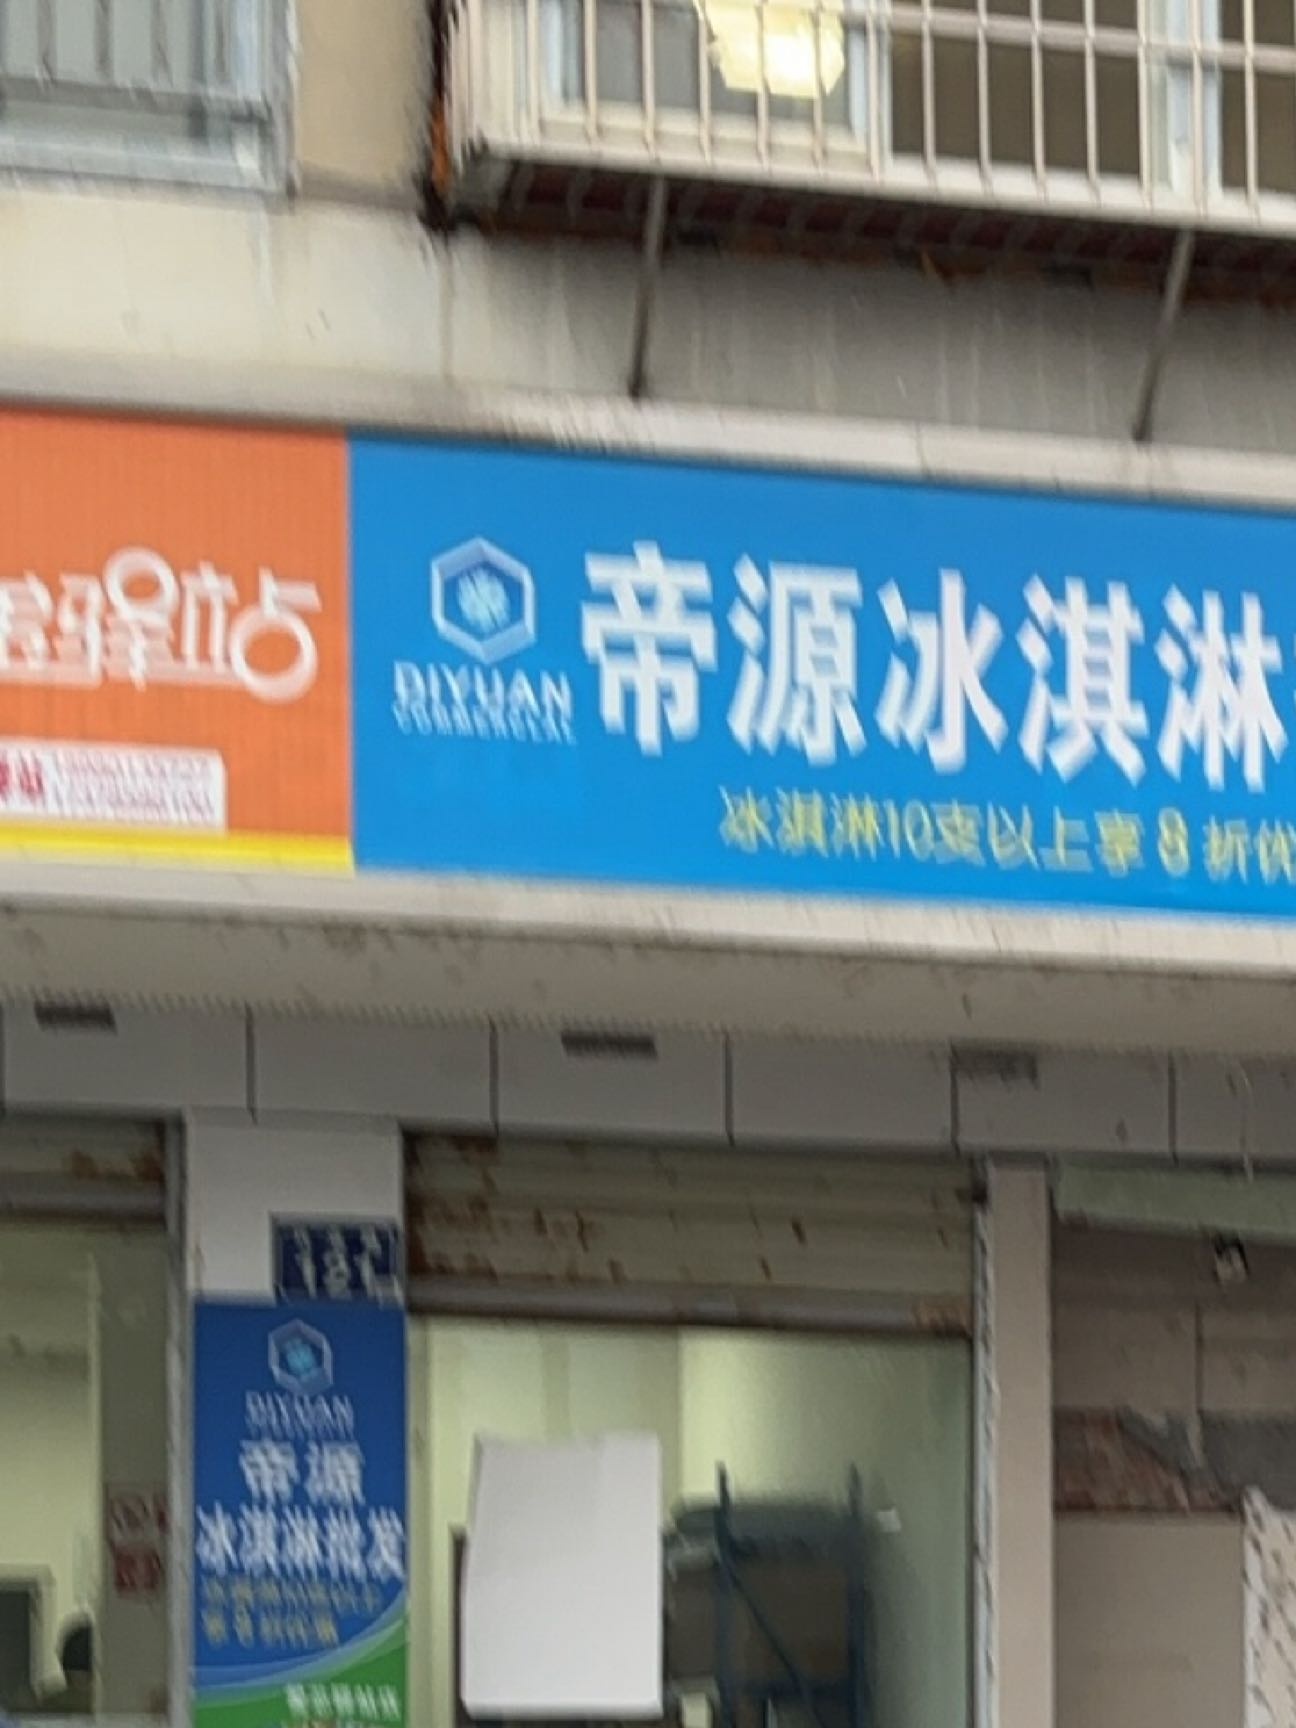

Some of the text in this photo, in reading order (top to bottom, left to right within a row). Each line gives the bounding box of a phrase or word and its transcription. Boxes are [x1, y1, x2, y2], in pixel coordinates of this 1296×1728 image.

[393, 660, 573, 718] DIYUAN
[238, 1438, 366, 1505] 帝源
[196, 1502, 406, 1583] 冰淇淋批发
